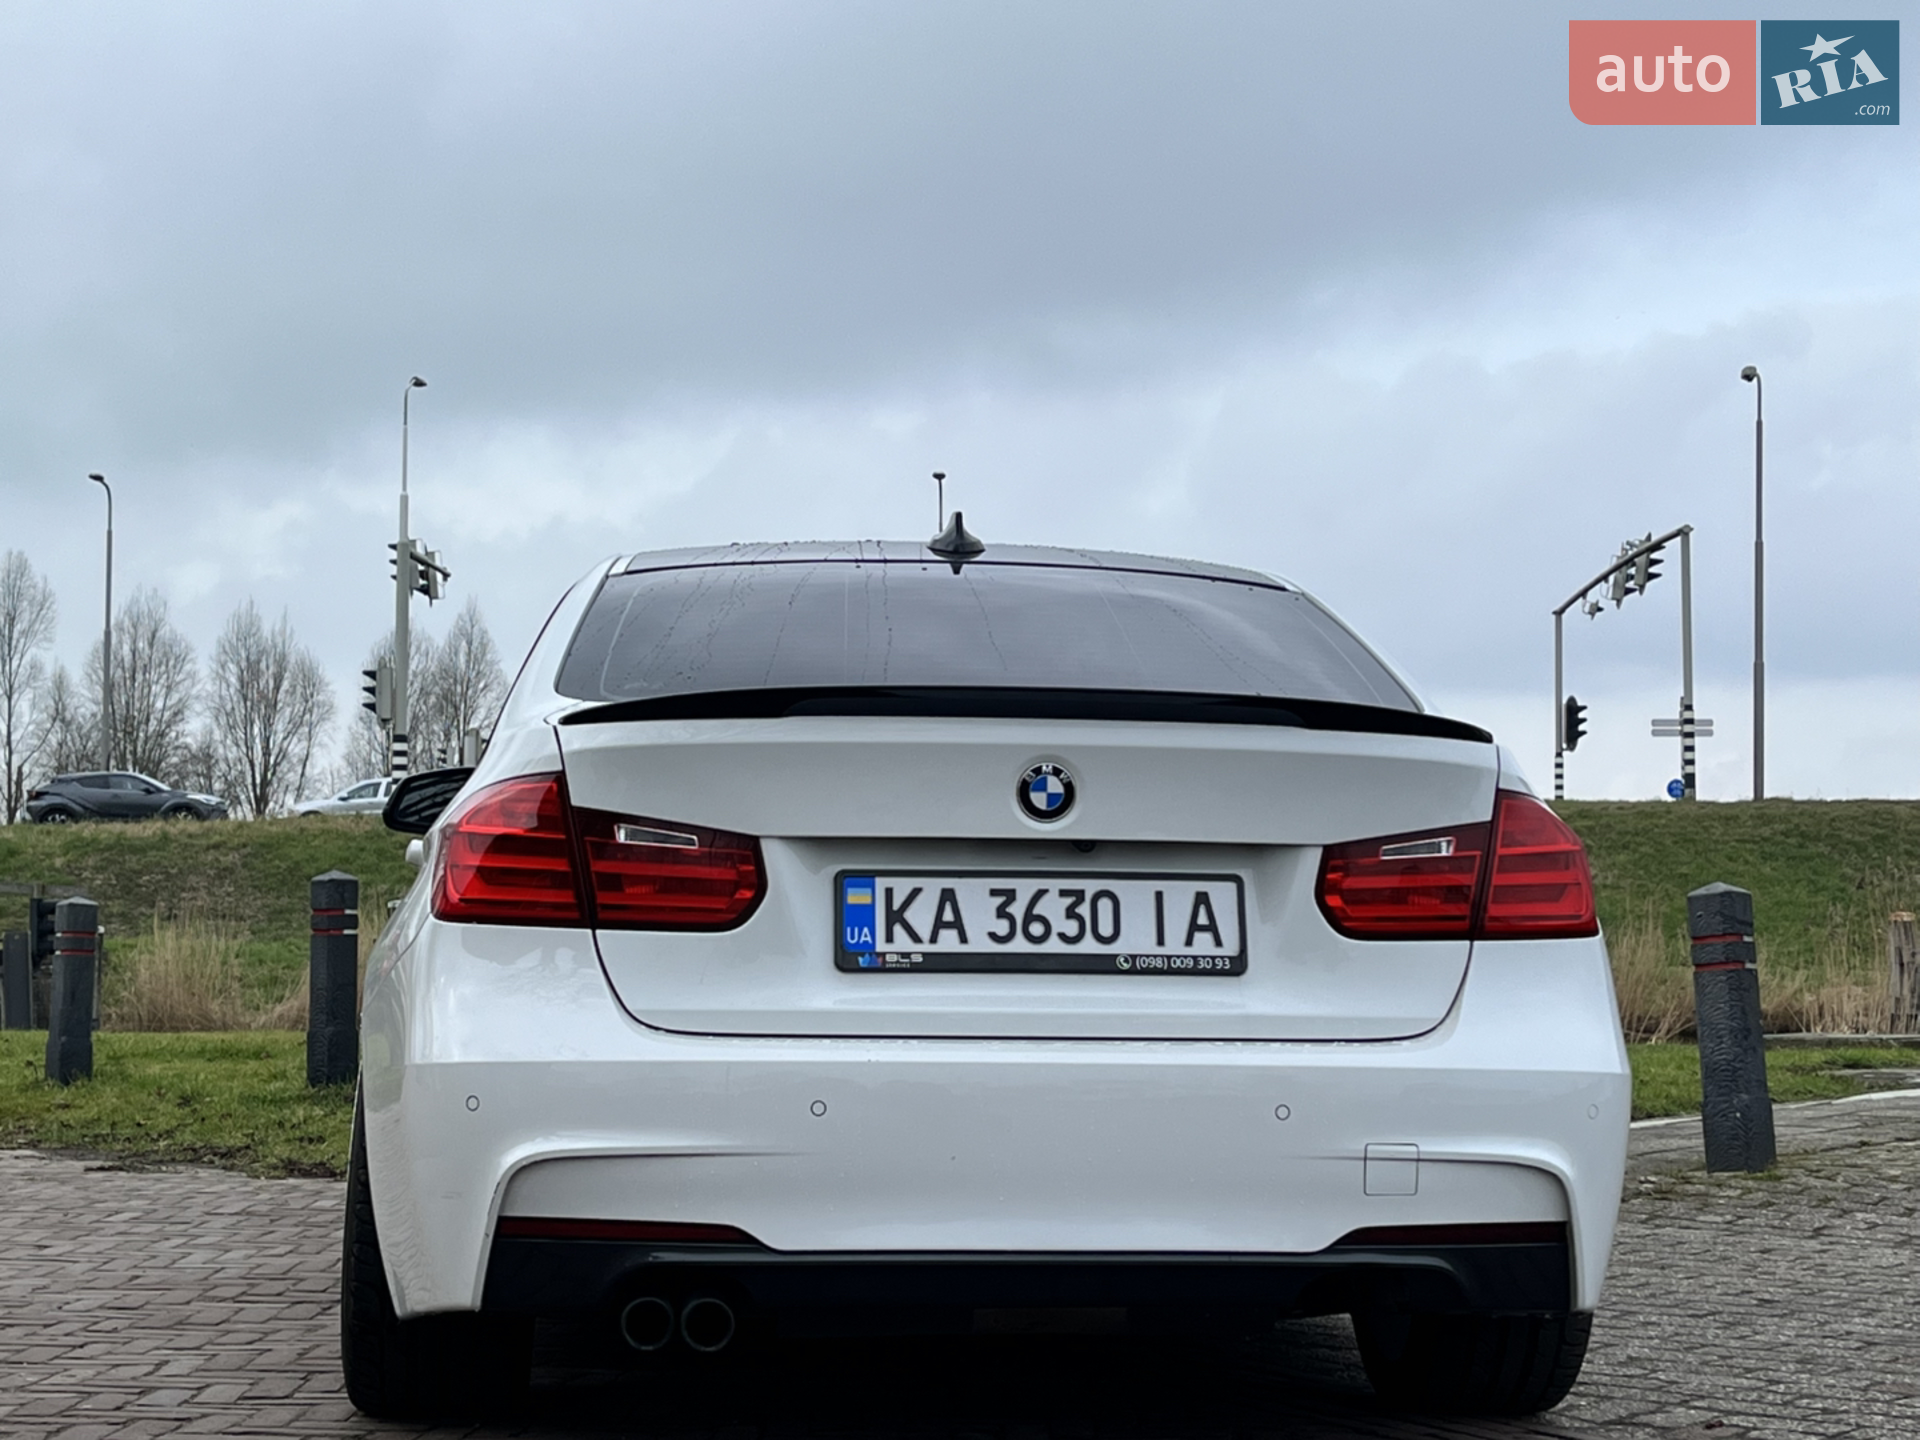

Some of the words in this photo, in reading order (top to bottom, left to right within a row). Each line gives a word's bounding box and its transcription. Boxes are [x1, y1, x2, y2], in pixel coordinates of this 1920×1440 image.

[1024, 764, 1071, 783] BMW
[884, 886, 970, 945] KA
[987, 888, 1121, 945] 3630
[846, 926, 873, 944] UA
[1135, 955, 1168, 970] (098)
[1170, 956, 1194, 969] 009
[1197, 957, 1212, 969] 30
[1214, 957, 1231, 970] 93
